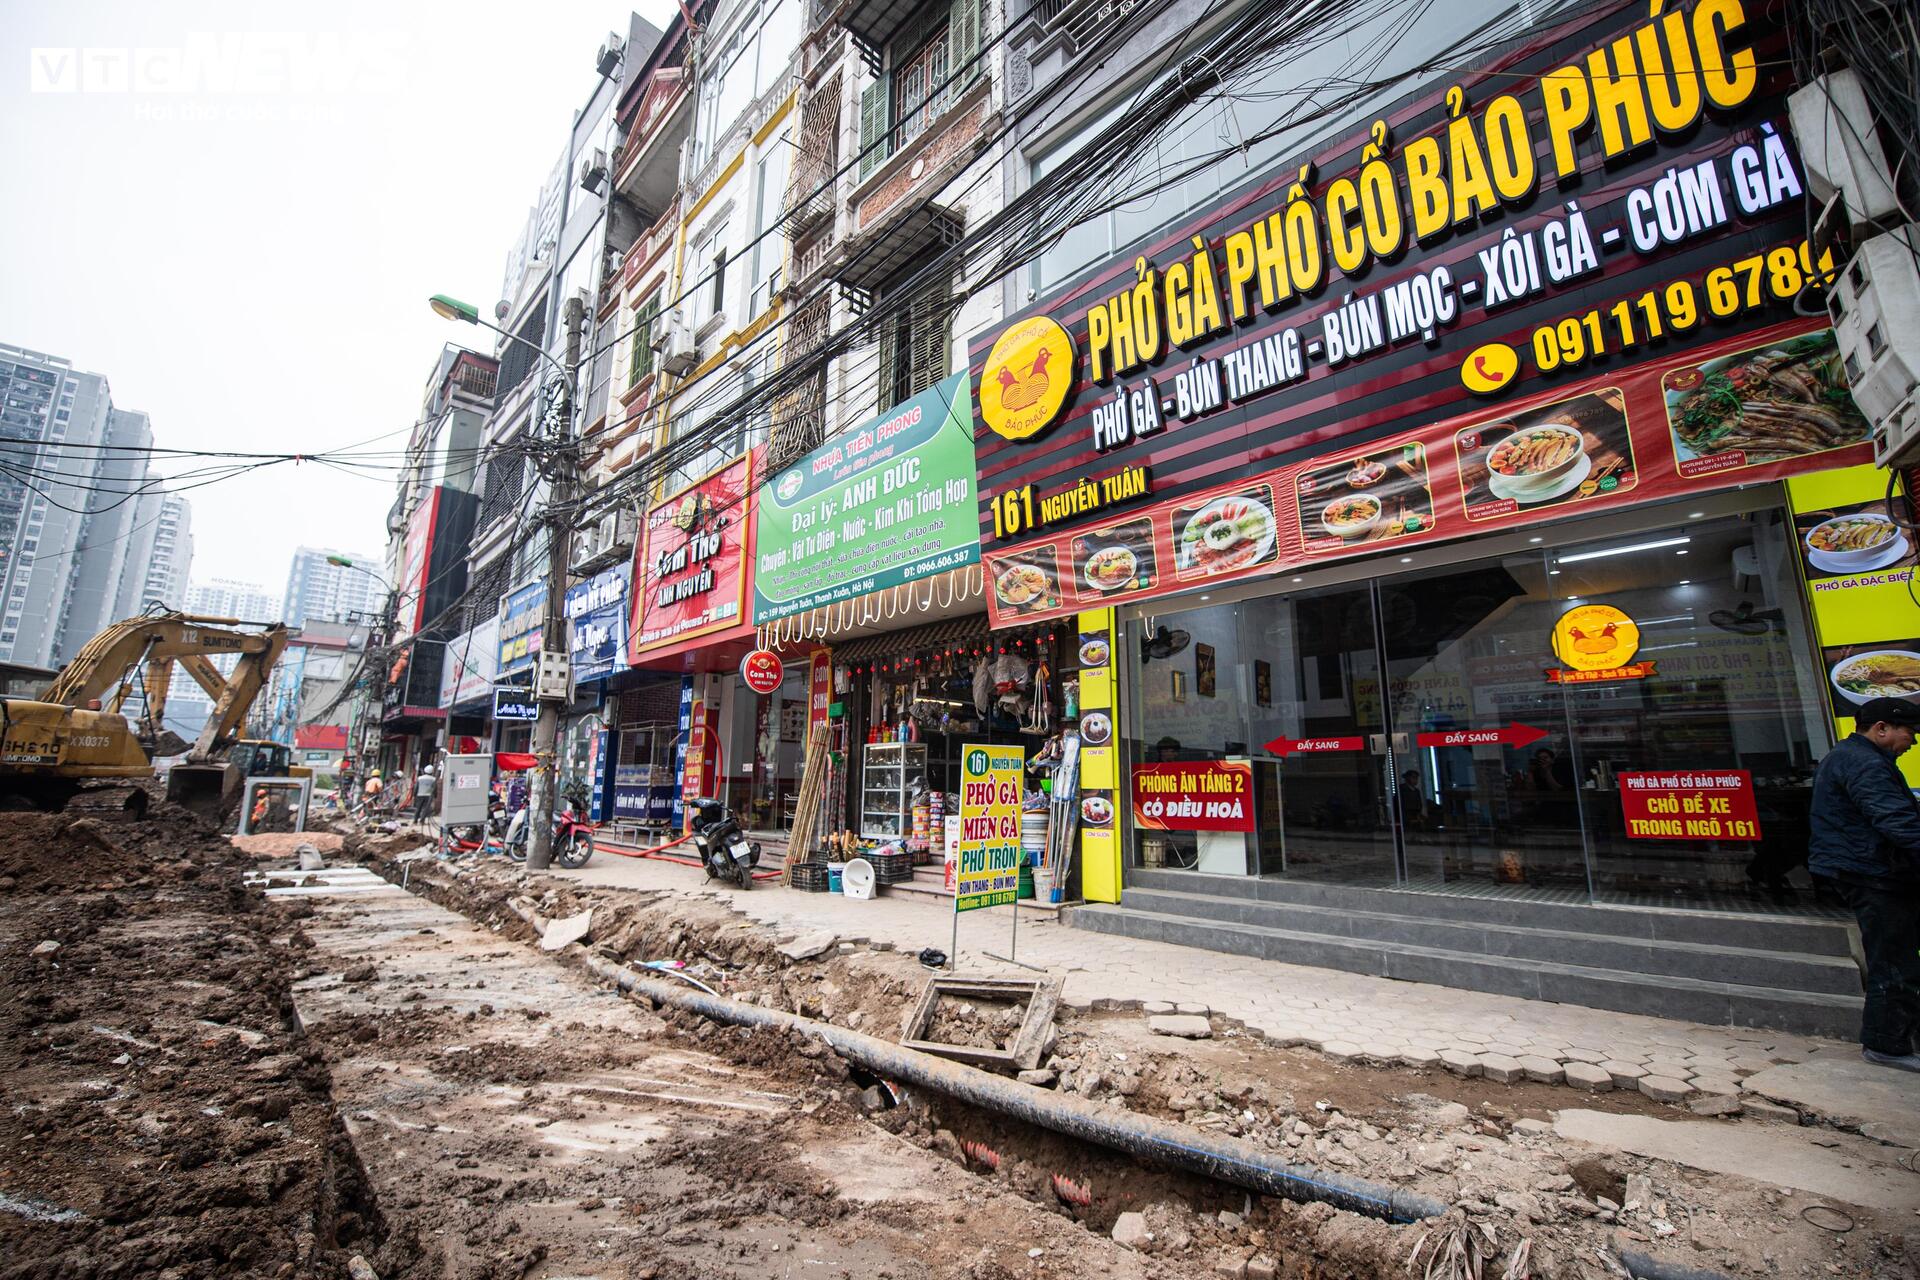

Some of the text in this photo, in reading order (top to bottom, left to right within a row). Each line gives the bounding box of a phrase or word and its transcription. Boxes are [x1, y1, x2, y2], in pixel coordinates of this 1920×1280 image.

[1087, 0, 1757, 383] PHỞ GÀ PHỐ CỔ BẢO PHÚC
[1093, 121, 1803, 449] PHỞ GÀ BÚN THANG BÚN MỌC XÔI GÀ CƠM GÀ
[1533, 311, 1604, 371] 091
[1609, 281, 1697, 347] 119
[877, 406, 922, 443] PHONG
[791, 456, 921, 534] Đại lý: ANH ĐỨC
[990, 467, 1146, 537] 161 NGUYỄN TUÂN
[842, 514, 867, 543] Nước
[874, 504, 895, 531] Kim
[896, 495, 913, 525] Khí
[916, 482, 942, 515] Tổng
[946, 477, 968, 506] Hợp
[917, 550, 969, 575] 0966.606.387
[1815, 571, 1915, 592] PHỞ GÀ ĐẶC BIỆT
[181, 630, 242, 649] X12 SUMITOMO
[1315, 740, 1340, 750] SANG
[1468, 732, 1498, 743] SANG
[971, 752, 987, 773] 161
[966, 773, 1019, 806] PHỞ GÀ
[1139, 768, 1244, 793] PHÒNG ĂN TẦNG 2
[1627, 773, 1741, 789] PHỞ GÀ PHỐ CỔ BẢO PHÚC
[1143, 795, 1244, 818] CÓ ĐIỀU HOÀ
[1647, 792, 1731, 814] CHỖ ĐỂ XE
[962, 809, 998, 841] MIẾN
[999, 810, 1018, 839] GÀ
[1630, 817, 1755, 837] TRONG NGÕ 161
[961, 842, 1017, 875] PHỞ TRỘN
[972, 878, 989, 894] THANG
